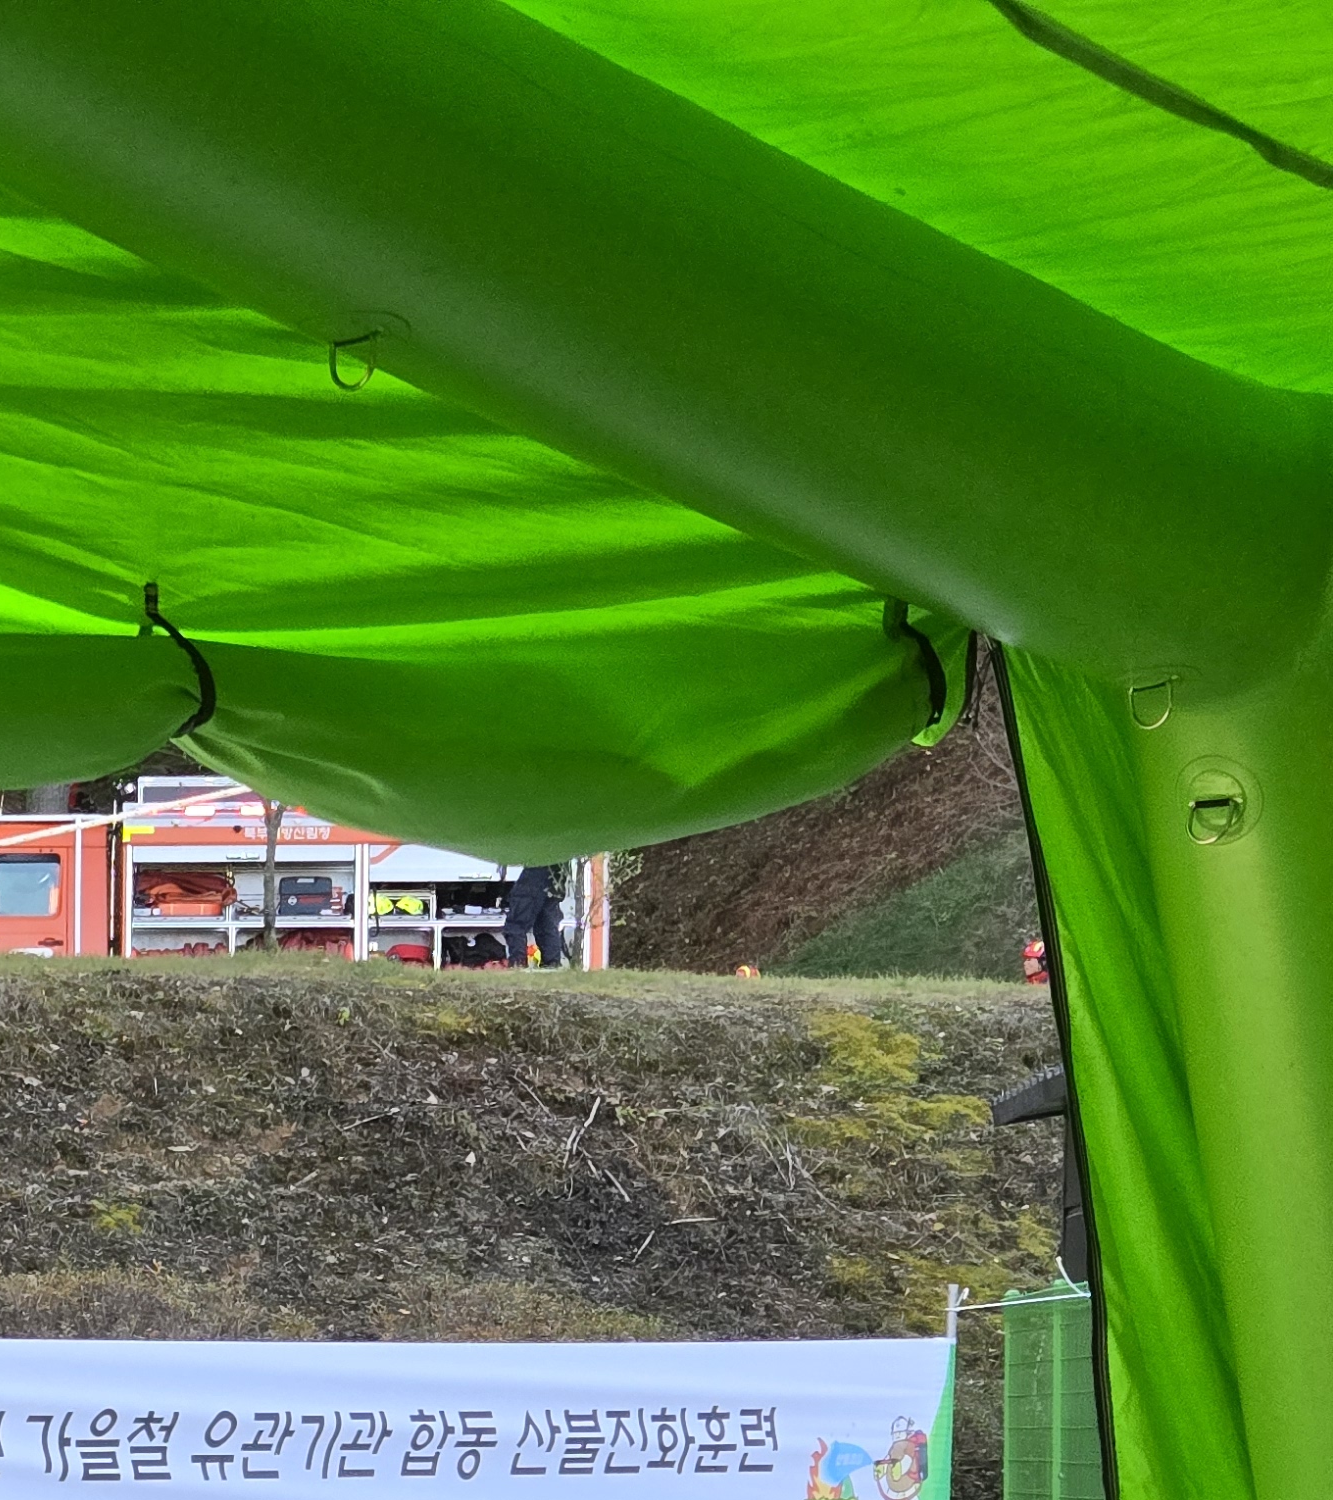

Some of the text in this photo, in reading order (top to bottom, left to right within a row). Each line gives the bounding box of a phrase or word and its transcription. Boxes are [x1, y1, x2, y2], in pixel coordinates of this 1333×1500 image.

[25, 1408, 181, 1482] 가을철
[190, 1409, 395, 1481] 유관기관
[399, 1408, 499, 1481] 합동
[509, 1405, 779, 1476] 산불진화훈련
